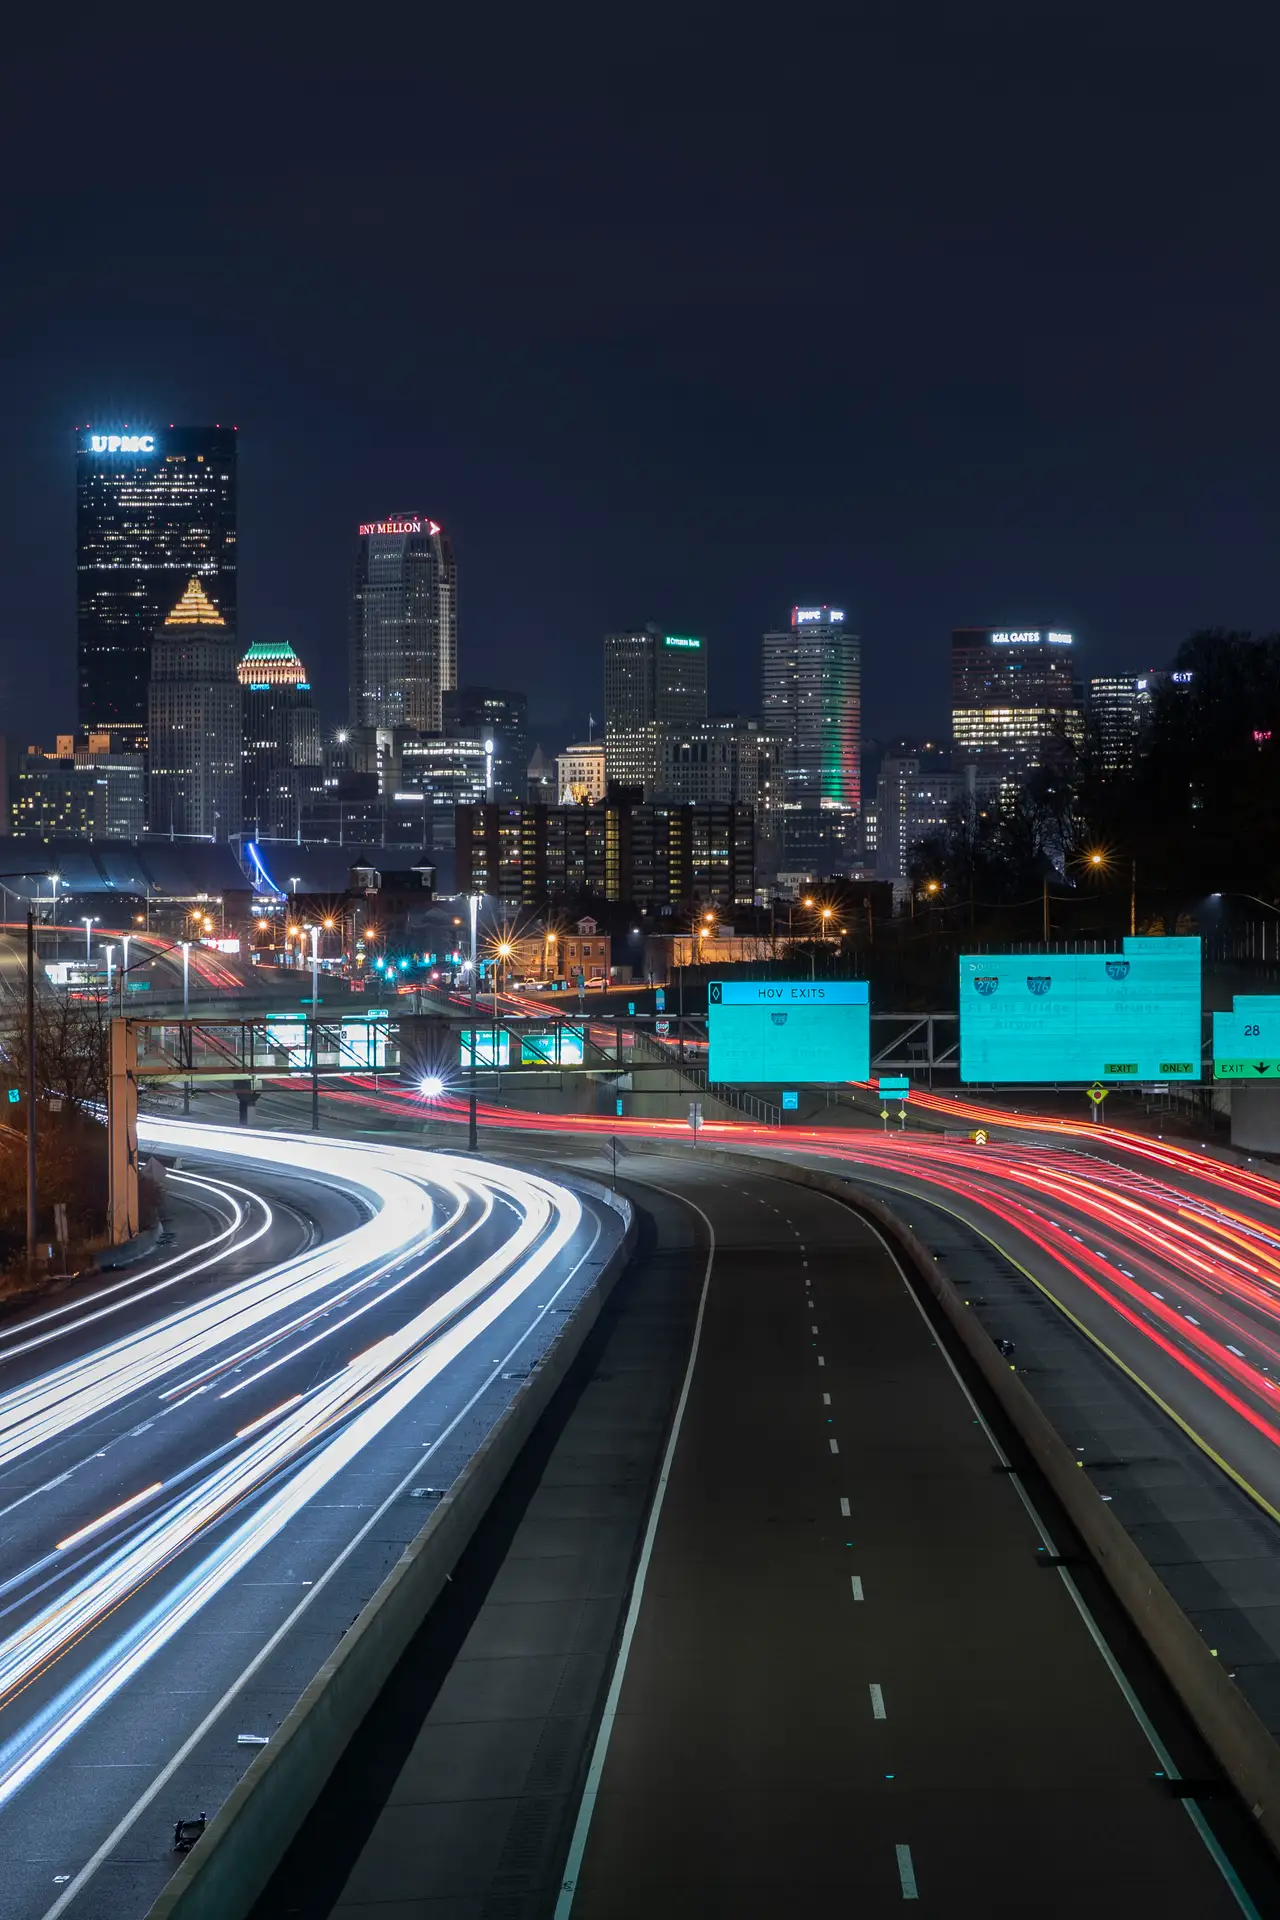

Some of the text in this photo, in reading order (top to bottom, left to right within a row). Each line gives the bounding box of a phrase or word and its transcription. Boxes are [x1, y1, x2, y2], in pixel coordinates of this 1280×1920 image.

[91, 436, 154, 452] UPMC
[377, 522, 421, 533] MELLON
[1010, 632, 1040, 643] GATES
[1108, 965, 1128, 978] 579
[977, 980, 996, 994] 279
[1029, 980, 1049, 994] 376
[758, 988, 826, 998] HOV EXITS
[1244, 1025, 1260, 1036] 28
[1109, 1063, 1190, 1073] EXIT ONLY
[1221, 1063, 1244, 1073] EXIT
